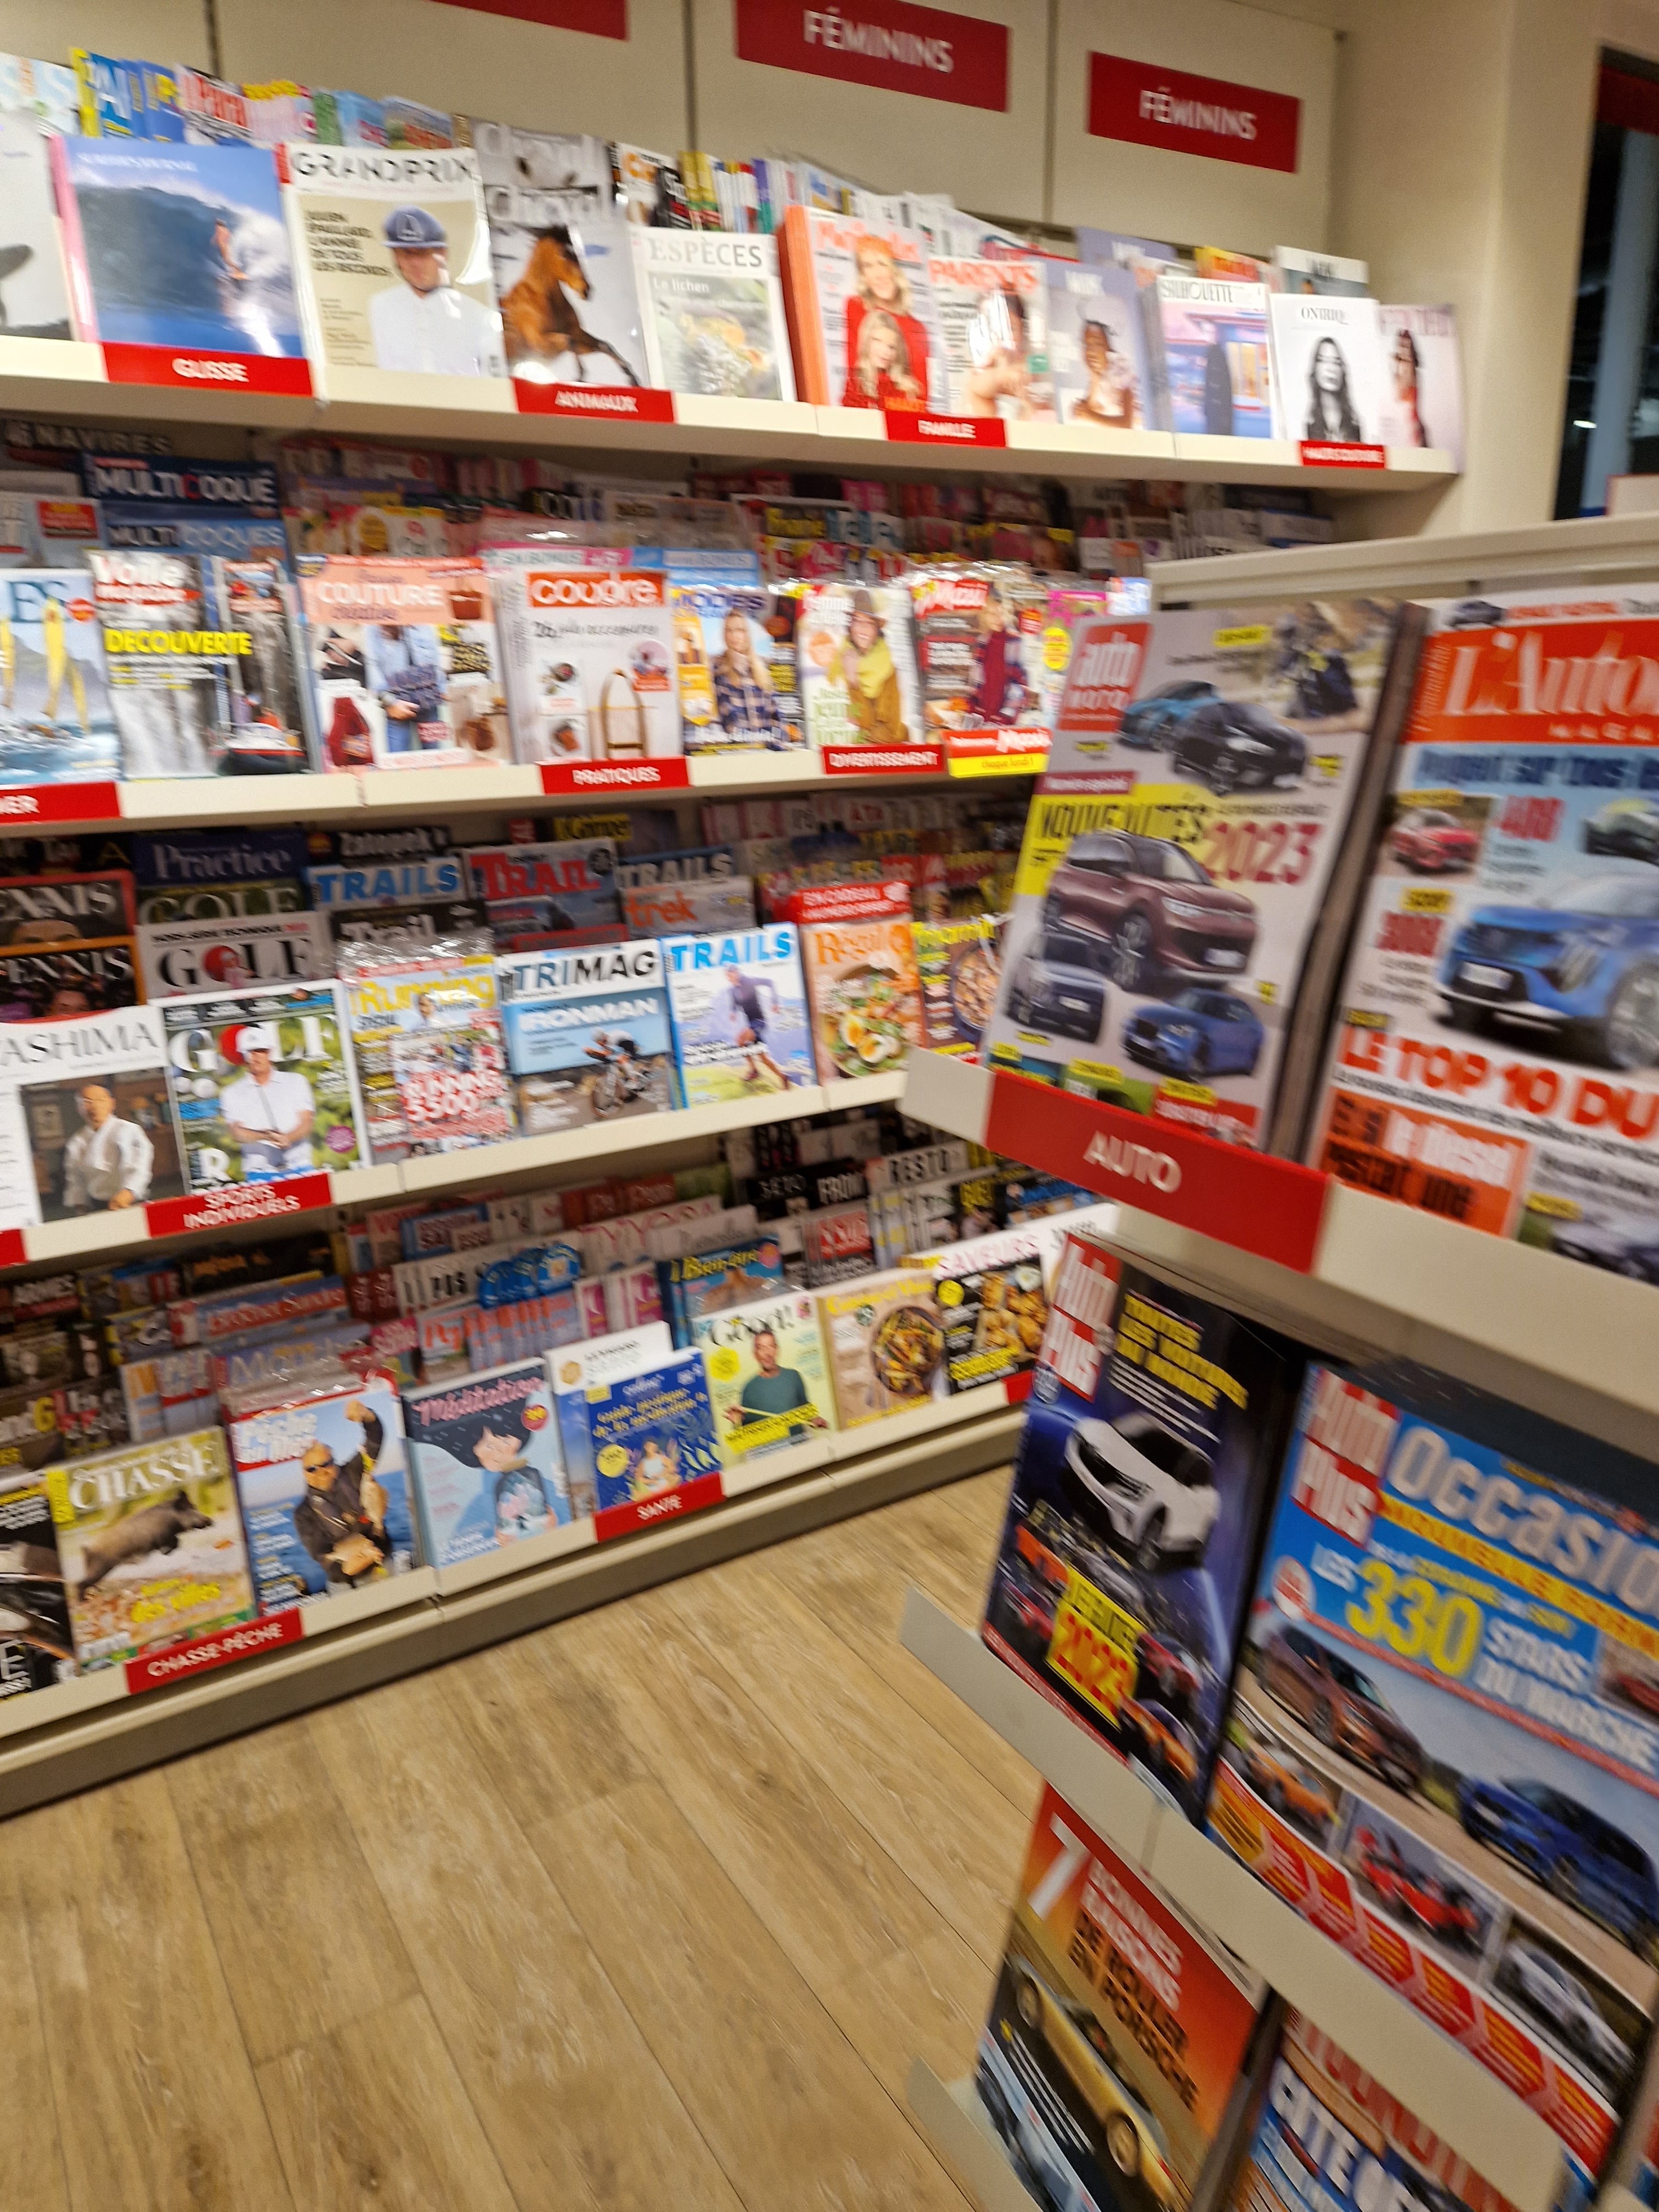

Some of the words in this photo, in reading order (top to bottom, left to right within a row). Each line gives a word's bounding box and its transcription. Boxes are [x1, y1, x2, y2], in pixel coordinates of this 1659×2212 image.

[805, 7, 953, 74] FÉMININS
[1139, 87, 1257, 142] FÉMININS
[294, 152, 476, 182] GRANDPRIX
[648, 237, 763, 268] ESPÈCES
[653, 278, 669, 291] Le
[671, 278, 710, 294] lichen
[928, 258, 1040, 293] PARENTS
[171, 358, 249, 382] GLISSE
[555, 389, 638, 413] ANIMAUX
[917, 419, 977, 439] FAMILLE
[320, 582, 442, 608] COUTURE
[531, 572, 659, 606] coudre
[573, 766, 661, 786] PRATIQUES
[830, 750, 940, 768] DIVERTISSEMENT
[982, 759, 1011, 769] chaque
[1013, 757, 1029, 768] lundi
[152, 843, 293, 879] Practice
[615, 852, 733, 887] TRAILS
[1206, 821, 1326, 886] 2023
[316, 863, 460, 902] TRAILS
[471, 853, 603, 900] TRAIL
[159, 939, 312, 989] GOLF
[670, 930, 792, 972] TRAILS
[514, 950, 656, 992] TRIMAG
[357, 972, 496, 1015] Running
[518, 997, 660, 1031] IRONMAN
[1340, 1025, 1387, 1073] LE
[1399, 1035, 1486, 1094] TOP
[1503, 1062, 1559, 1116] 10
[1571, 1074, 1659, 1140] DU
[1083, 1129, 1183, 1194] AUTO
[184, 1194, 302, 1230] INDIVIDUELS
[204, 1185, 276, 1210] SPORTS
[932, 1234, 1039, 1277] SAVEURS
[69, 1439, 219, 1514] CHASSE
[637, 1494, 683, 1522] SANTÉ
[1386, 1425, 1659, 1620] Occasio
[1344, 1556, 1484, 1680] 330
[147, 1621, 284, 1678] CHASSE-PÊCHE
[1026, 1809, 1094, 1923] 7
